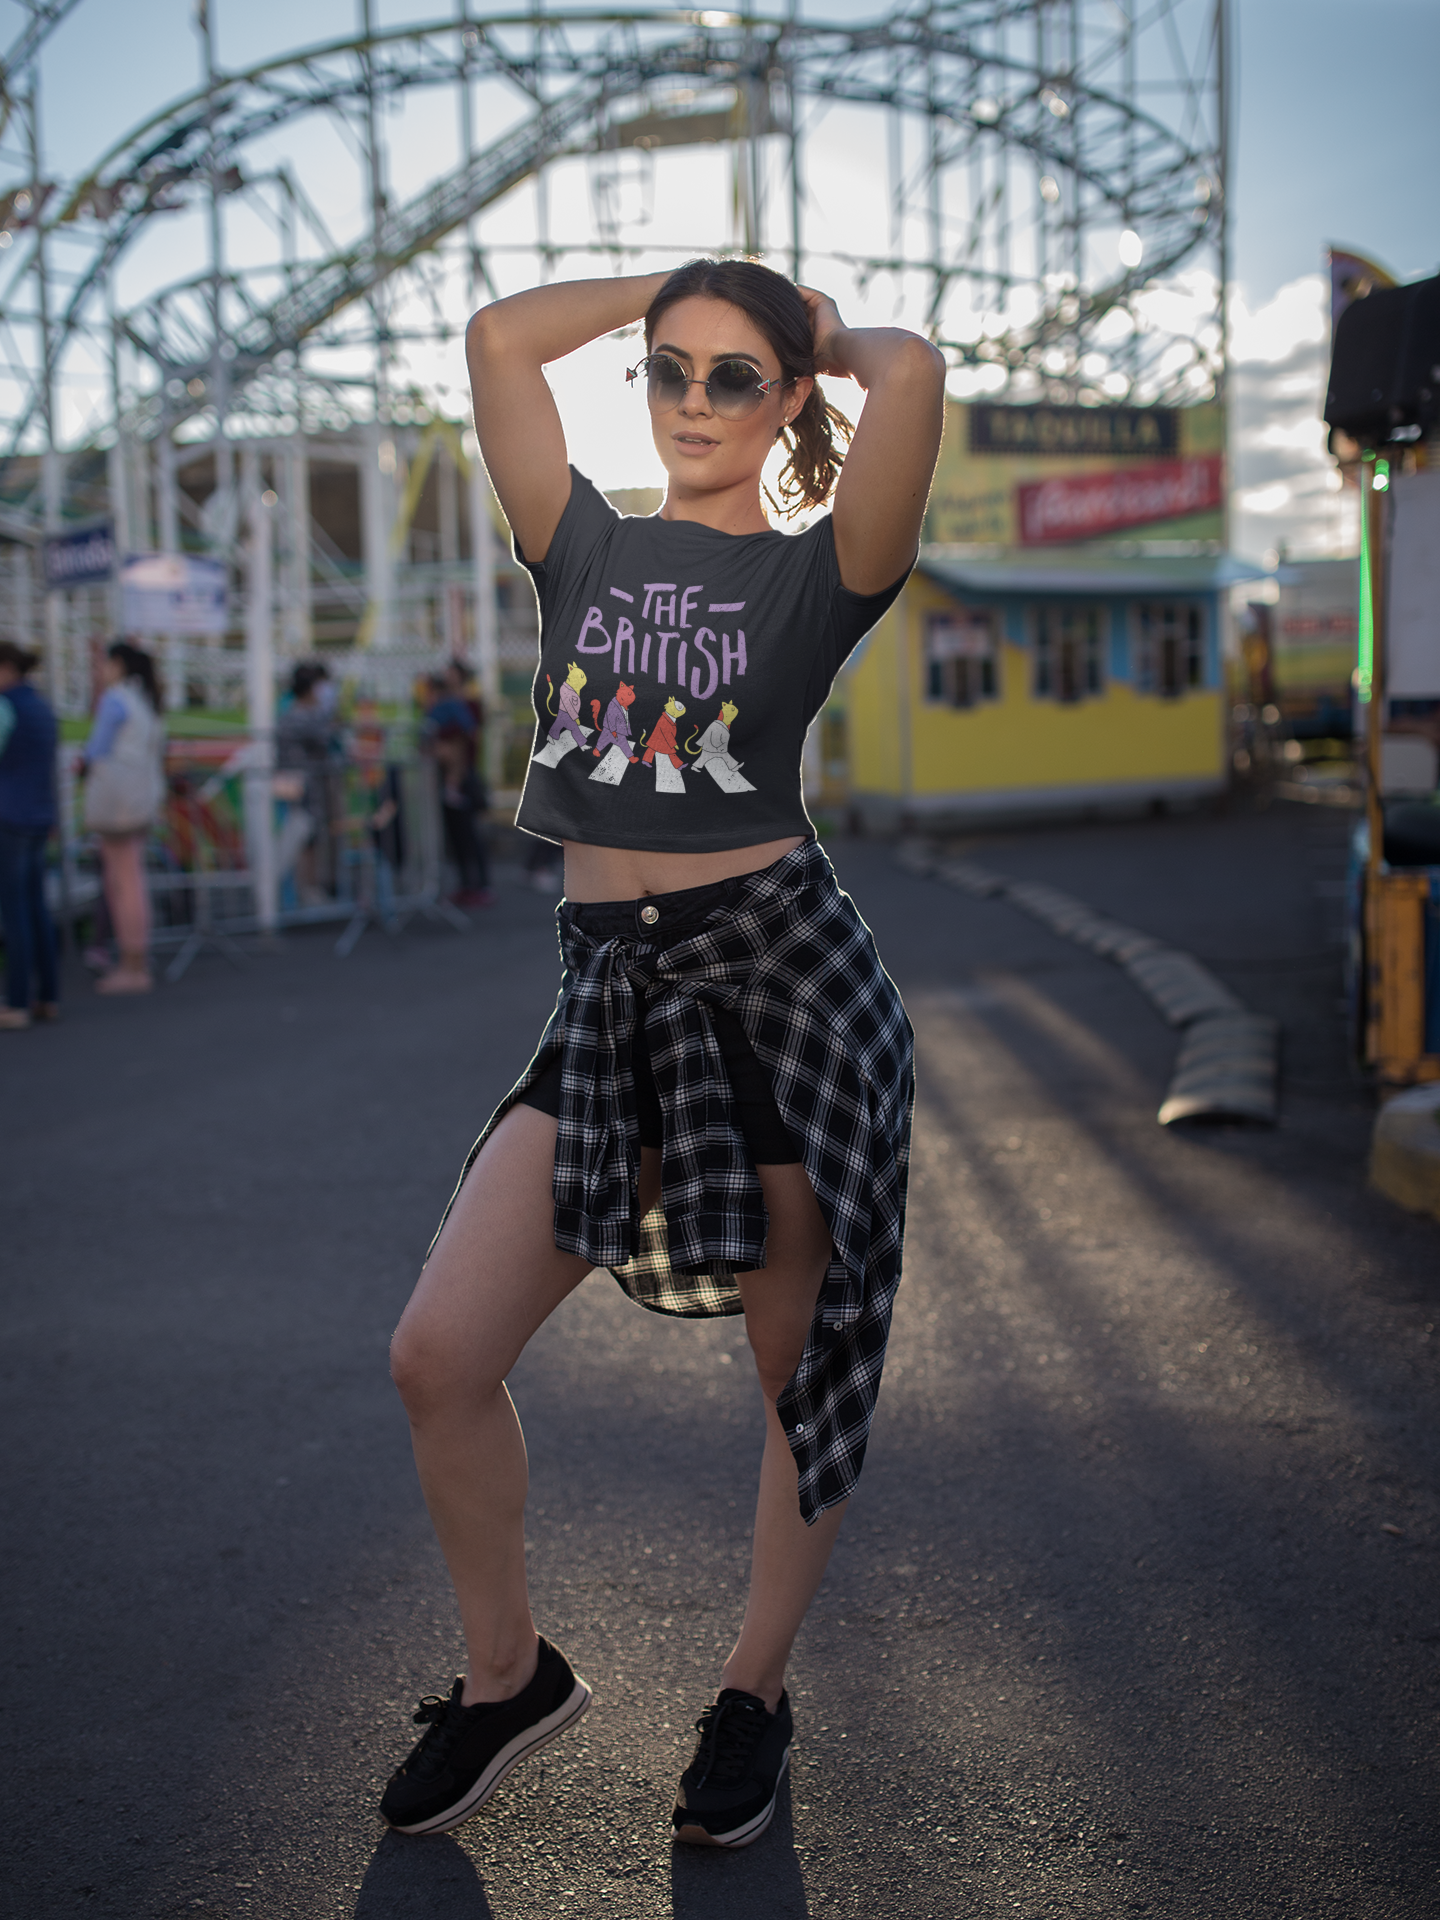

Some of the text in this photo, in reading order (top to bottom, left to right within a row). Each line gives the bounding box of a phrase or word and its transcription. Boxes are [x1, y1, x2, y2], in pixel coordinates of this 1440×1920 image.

[992, 411, 1158, 444] TAQUILLA
[641, 583, 703, 628] THE
[575, 606, 748, 700] BRITISH
